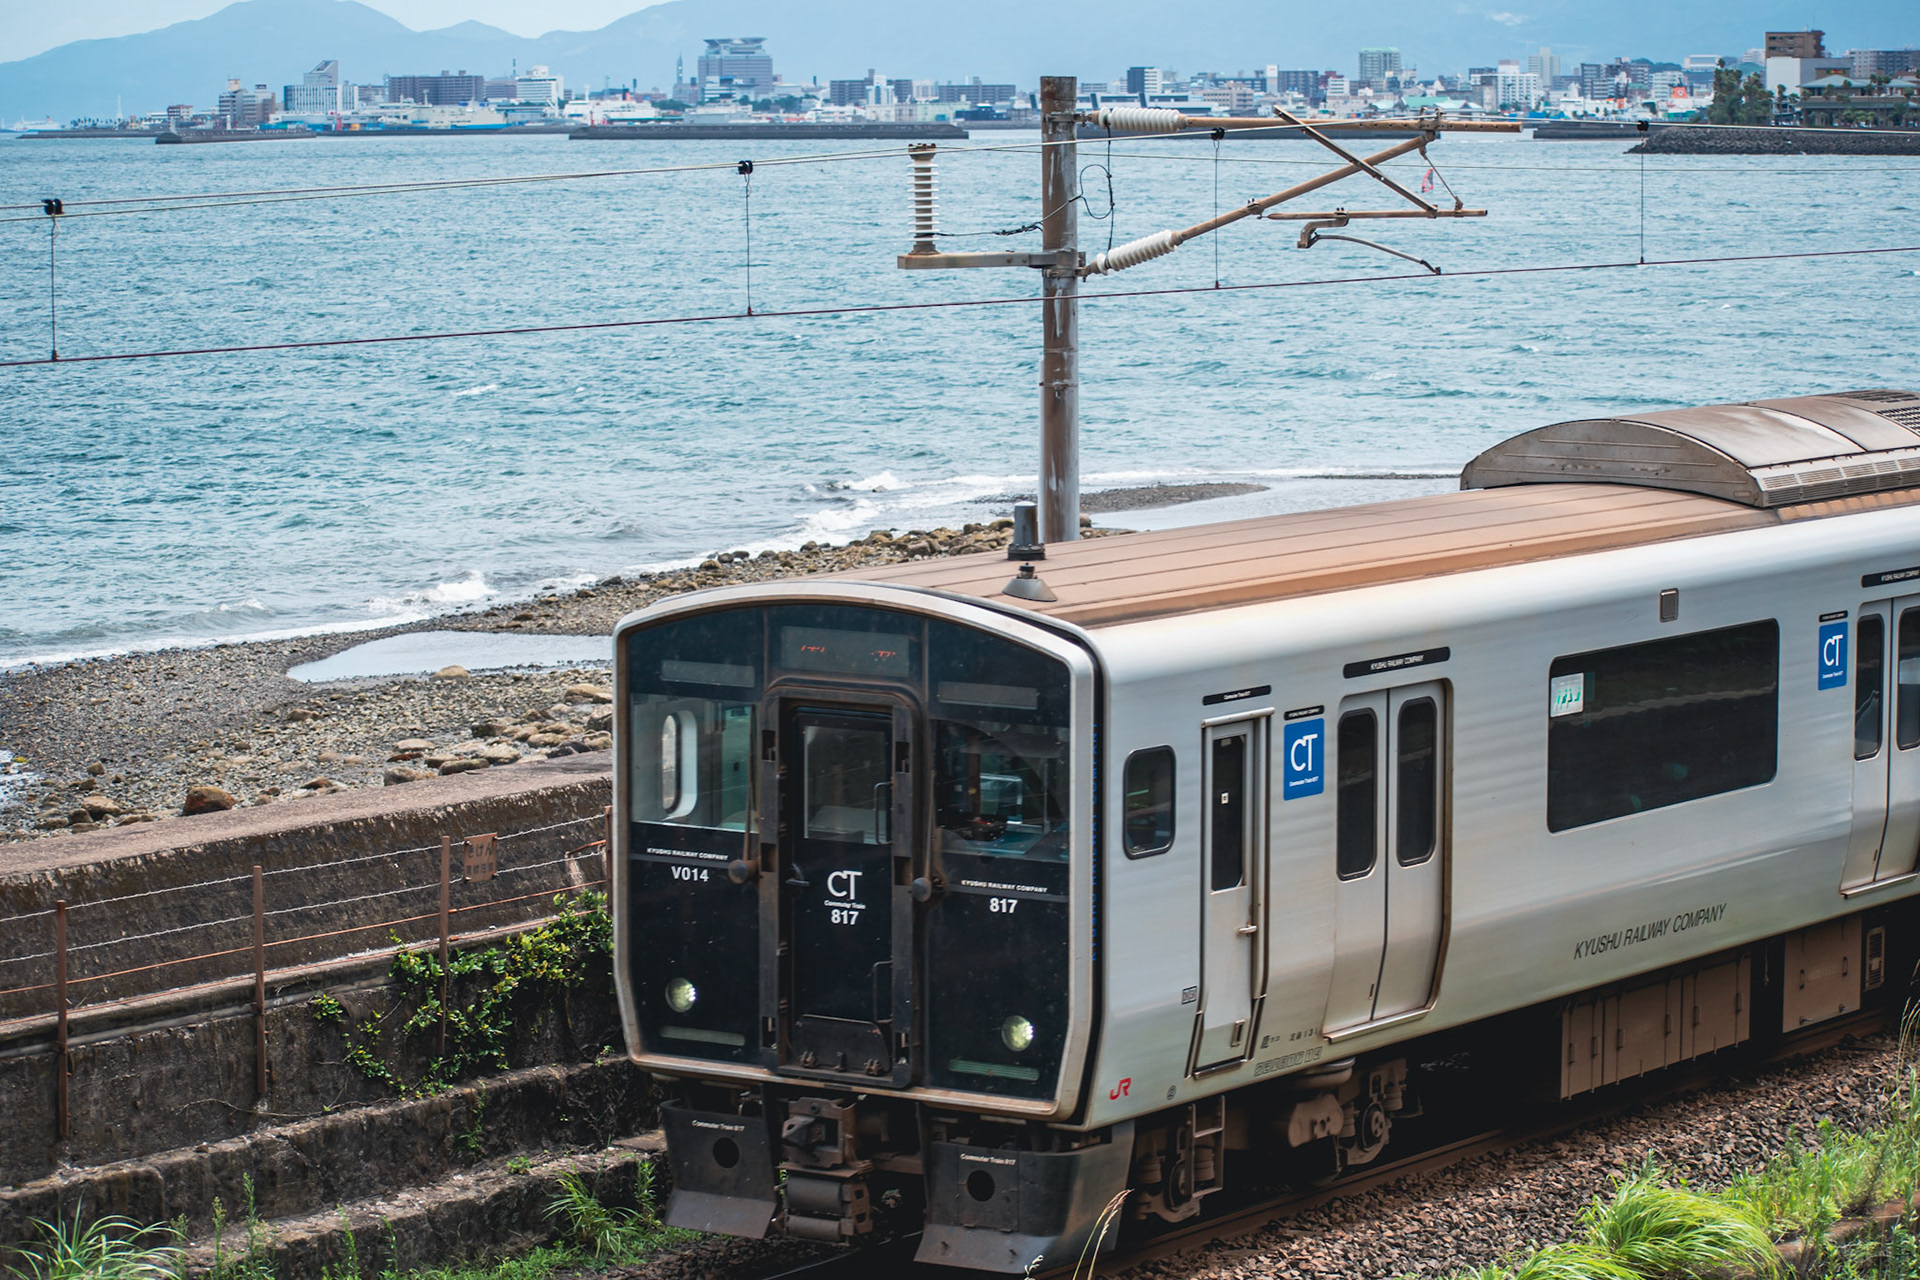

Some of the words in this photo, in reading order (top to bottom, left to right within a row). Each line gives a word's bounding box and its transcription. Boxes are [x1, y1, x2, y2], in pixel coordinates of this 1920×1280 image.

[1823, 634, 1844, 667] CT
[1290, 733, 1319, 772] CT
[647, 847, 671, 855] KYUSHU
[672, 850, 699, 858] RAILWAY
[699, 852, 728, 860] COMPANY
[671, 866, 709, 882] V014
[827, 870, 863, 900] CT
[961, 880, 987, 888] KYUSHU
[988, 882, 1016, 890] RAILWAY
[1016, 885, 1048, 893] COMPANY
[989, 897, 1018, 913] 817
[831, 909, 859, 925] 817
[1573, 931, 1623, 960] KYUSHU
[1623, 917, 1672, 946] RAILWAY
[1672, 903, 1727, 933] COMPANY
[1109, 1077, 1132, 1101] JR
[692, 1119, 719, 1129] Commuter
[719, 1123, 734, 1131] Train
[960, 1153, 989, 1162] Commuter
[990, 1156, 1004, 1164] Train
[1005, 1158, 1016, 1166] 817
